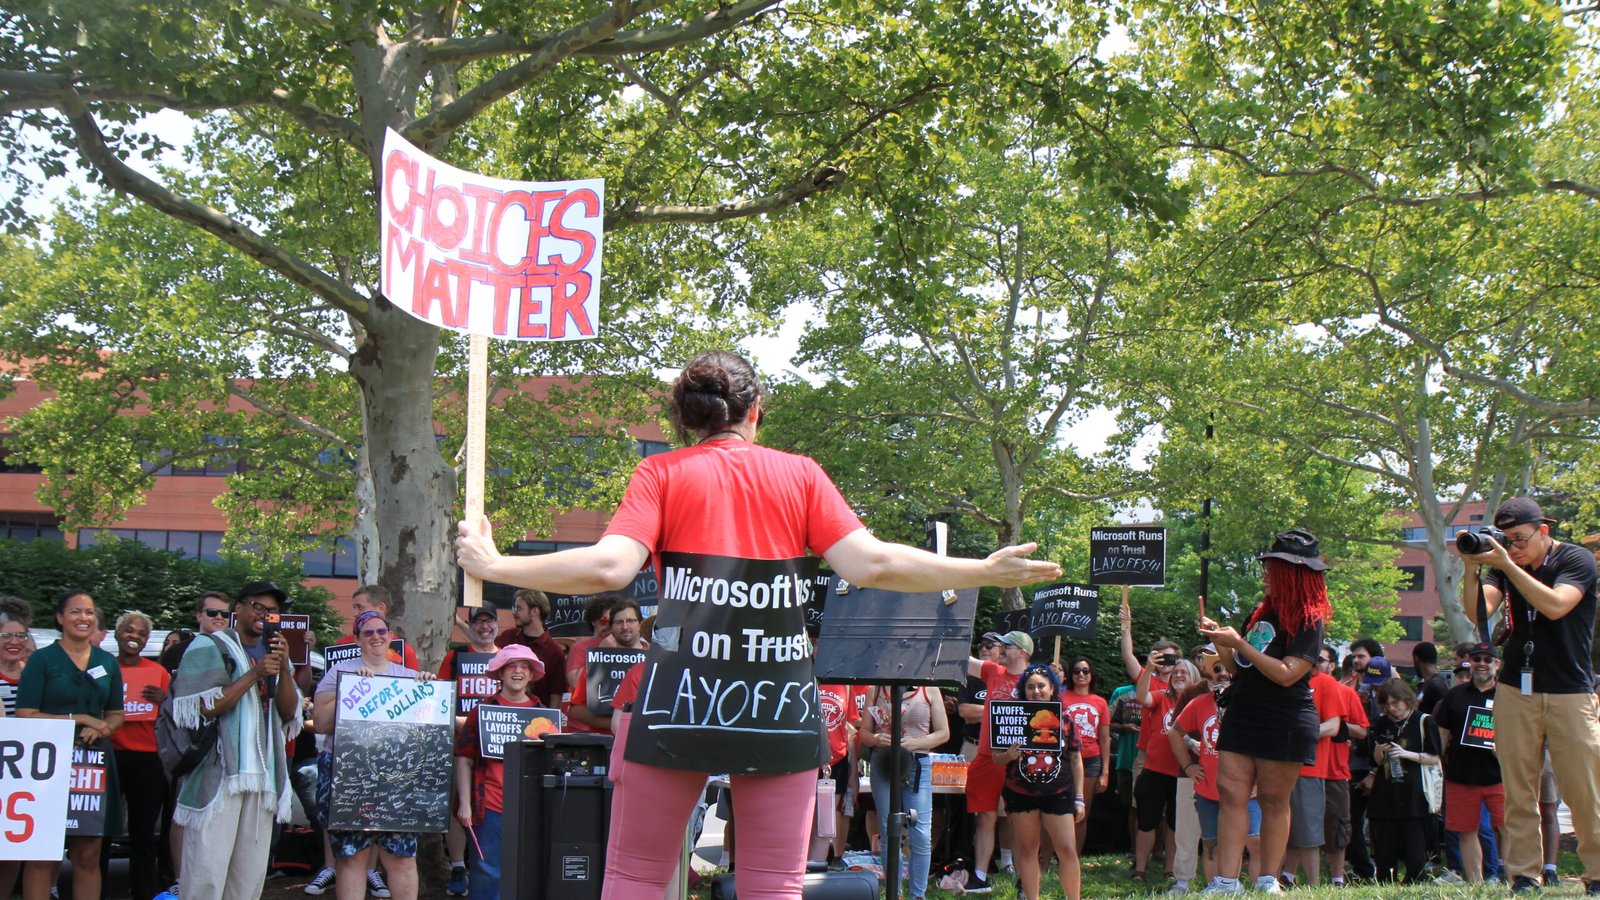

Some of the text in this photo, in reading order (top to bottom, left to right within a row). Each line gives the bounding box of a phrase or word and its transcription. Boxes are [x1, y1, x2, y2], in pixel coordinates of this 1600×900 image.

[385, 149, 600, 276] CHOICES
[386, 221, 595, 339] MATTER
[1092, 531, 1163, 540] Microsoft Runs
[1121, 545, 1146, 554] Trust
[664, 567, 792, 609] Microsoft
[1034, 586, 1098, 600] Microsoft Runs
[557, 597, 570, 606] on
[1044, 599, 1080, 609] on Trust
[281, 621, 294, 629] UNS
[692, 627, 809, 662] on Trust
[588, 651, 646, 663] Microsoft
[610, 670, 626, 679] on
[461, 678, 501, 694] FIGH
[341, 678, 372, 711] DEVS
[358, 679, 403, 718] BEFORE
[991, 705, 1031, 716] LAYOFFS...
[481, 710, 526, 723] LAYOFFS...
[995, 716, 1028, 726] LAYOFFS
[1475, 714, 1489, 722] THIS
[485, 722, 522, 734] LAYOFFS
[999, 725, 1024, 735] NEVER
[490, 733, 517, 744] NEVER
[996, 736, 1028, 746] CHANGE
[487, 744, 504, 754] CHA
[87, 750, 105, 764] WE
[70, 794, 101, 812] WIN
